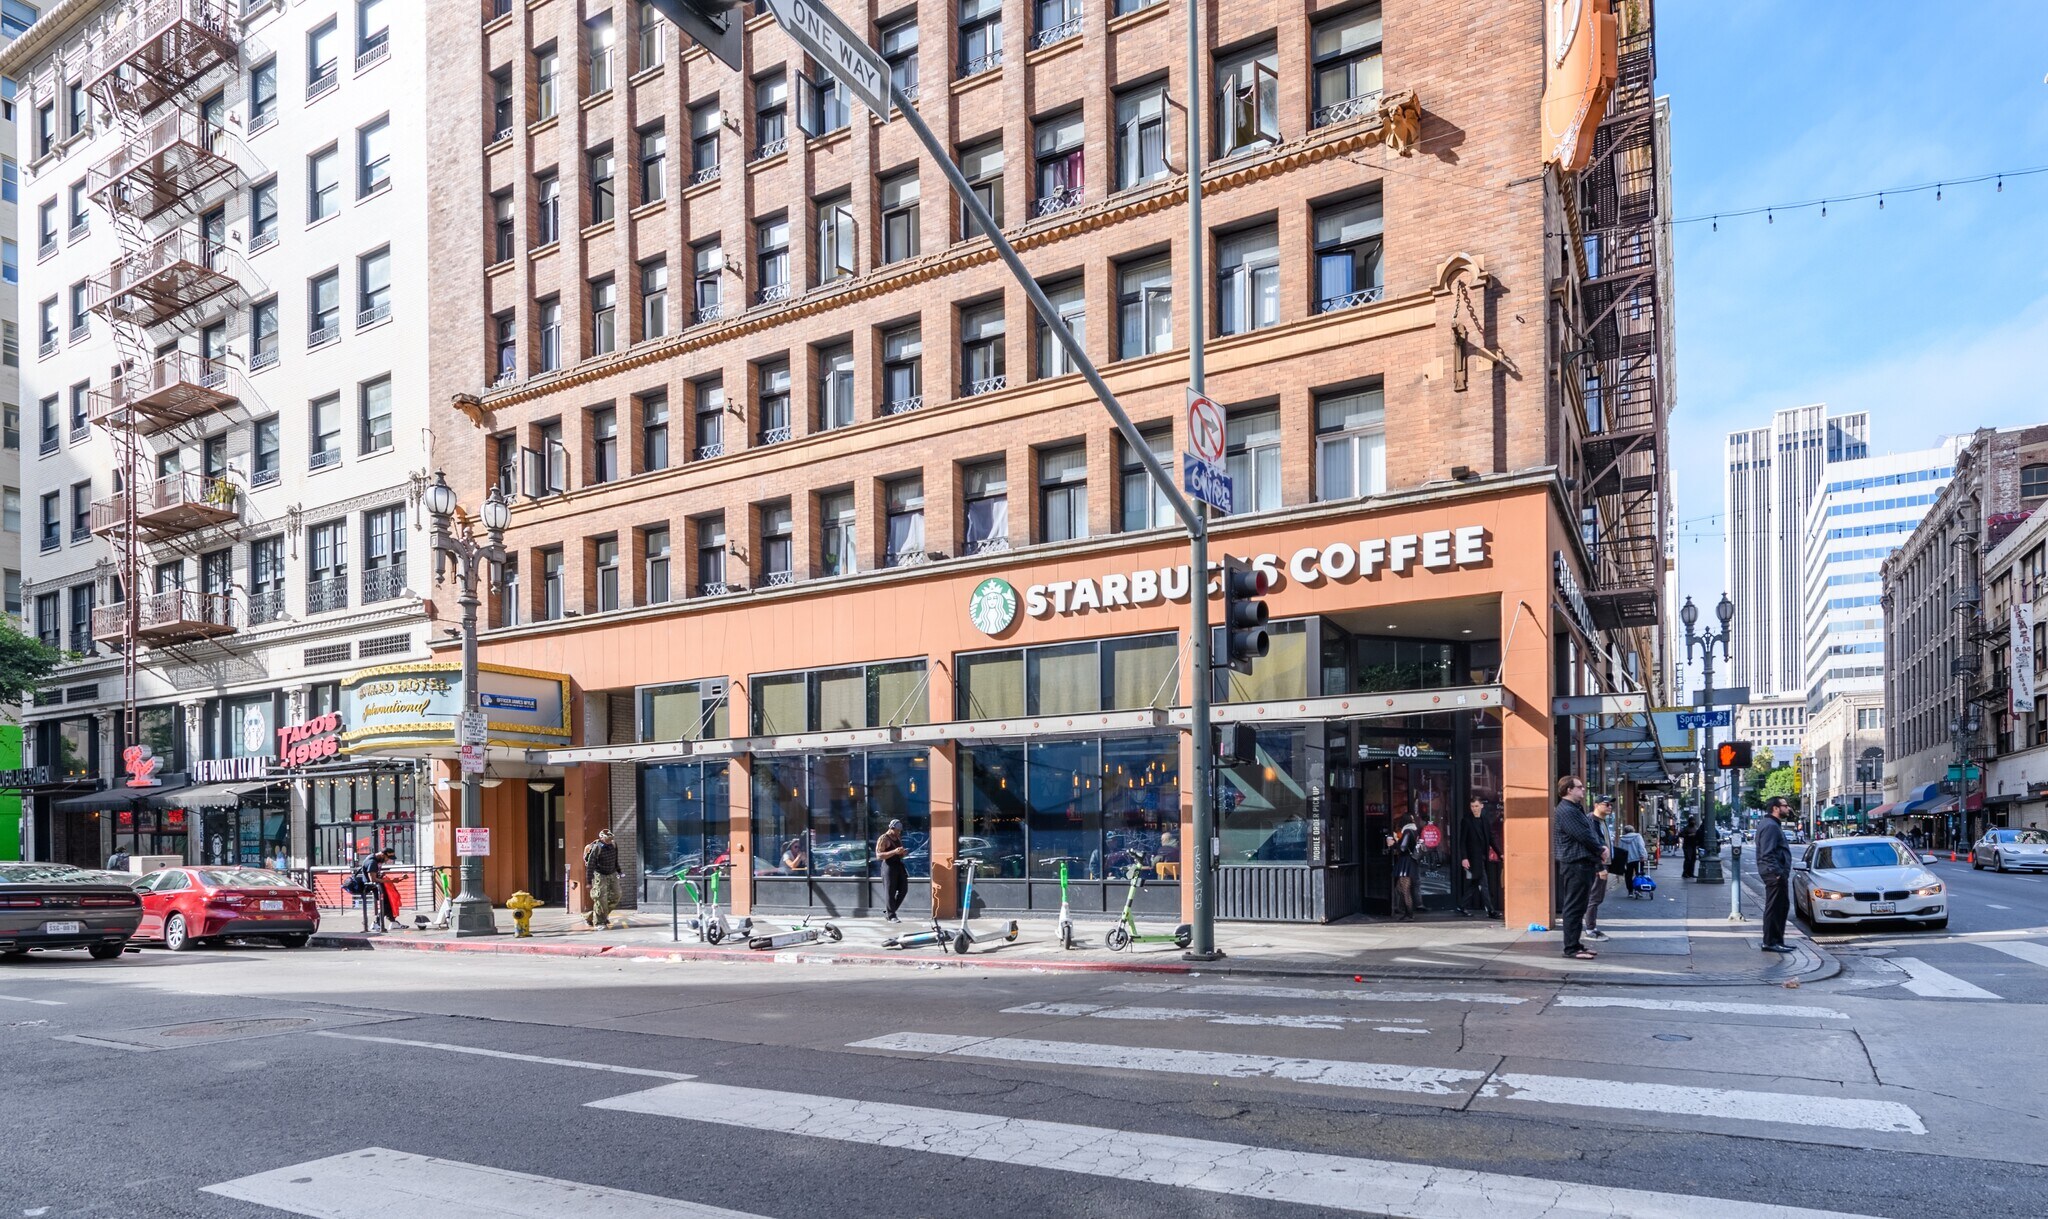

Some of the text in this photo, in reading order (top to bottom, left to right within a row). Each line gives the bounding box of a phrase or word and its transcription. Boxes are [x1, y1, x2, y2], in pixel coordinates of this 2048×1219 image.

[794, 0, 875, 88] ONE WAY
[1026, 525, 1484, 616] STARBUS COFFEE
[397, 677, 452, 695] HOTEL
[362, 698, 431, 723] International
[1680, 711, 1727, 725] Spring St
[278, 713, 337, 762] TACOS
[287, 736, 337, 767] 1986
[1397, 745, 1418, 757] 603
[193, 756, 267, 782] THE DOLLY LLAMA
[1312, 786, 1320, 796] UP
[1312, 796, 1320, 812] PICK
